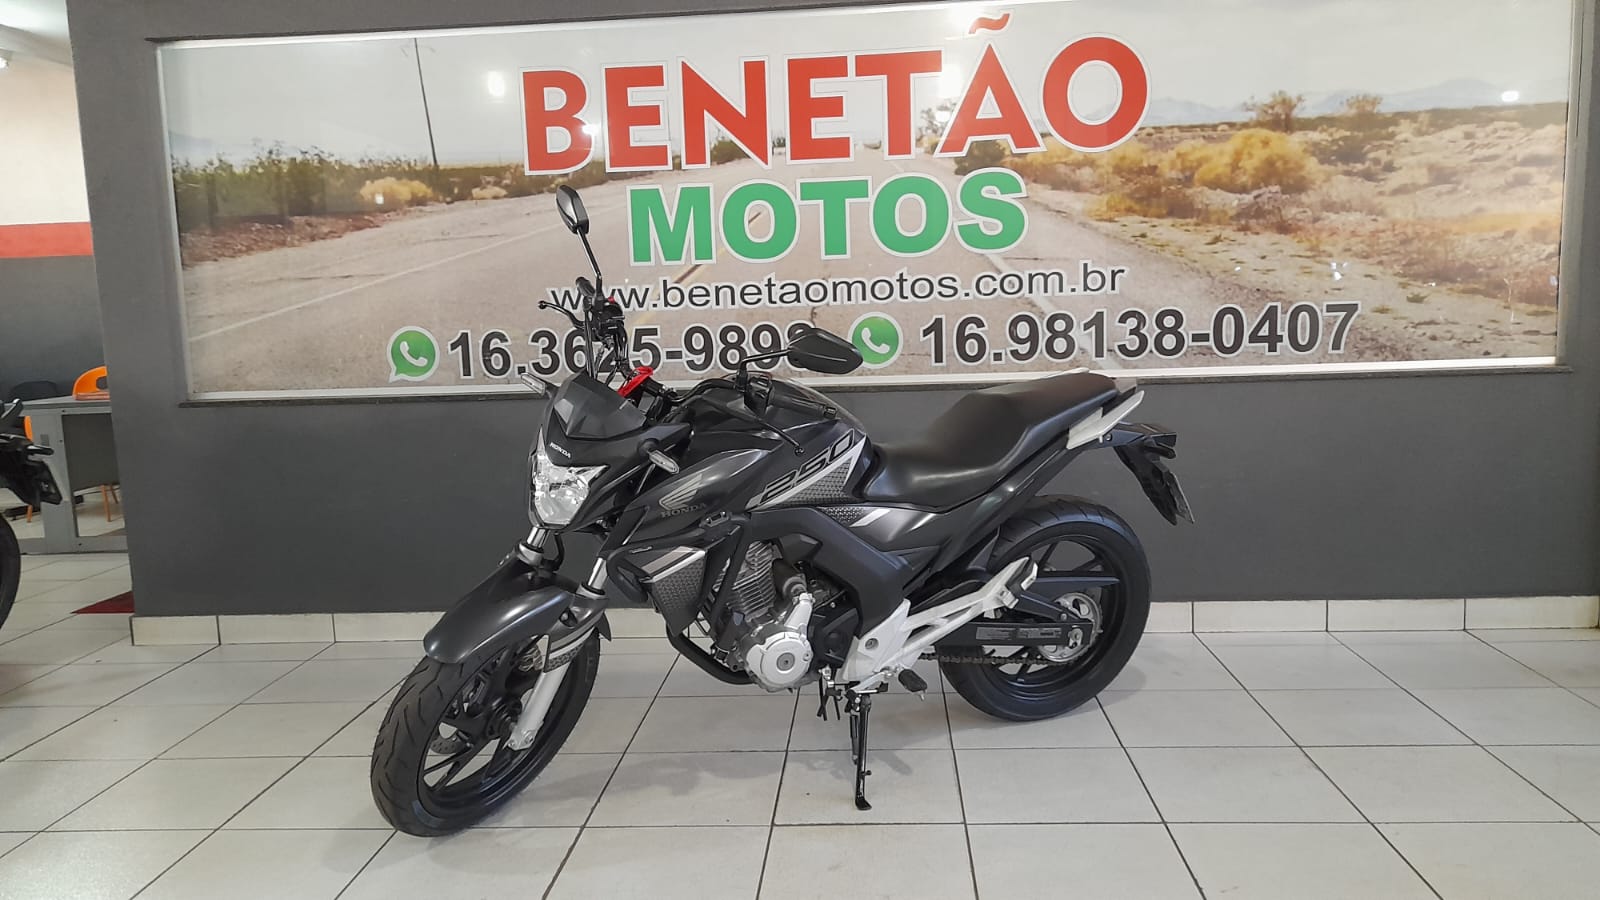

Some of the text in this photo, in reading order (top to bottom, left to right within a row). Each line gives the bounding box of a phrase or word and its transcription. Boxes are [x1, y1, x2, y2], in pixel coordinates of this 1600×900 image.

[521, 13, 1149, 174] BENETÃO
[629, 170, 1028, 264] MOTOS
[550, 262, 1126, 311] ww.benetaomotos.com.br
[921, 302, 1360, 364] 16.98138-0407
[549, 441, 572, 459] HONDA
[760, 428, 855, 506] 250
[660, 502, 707, 518] HONDA
